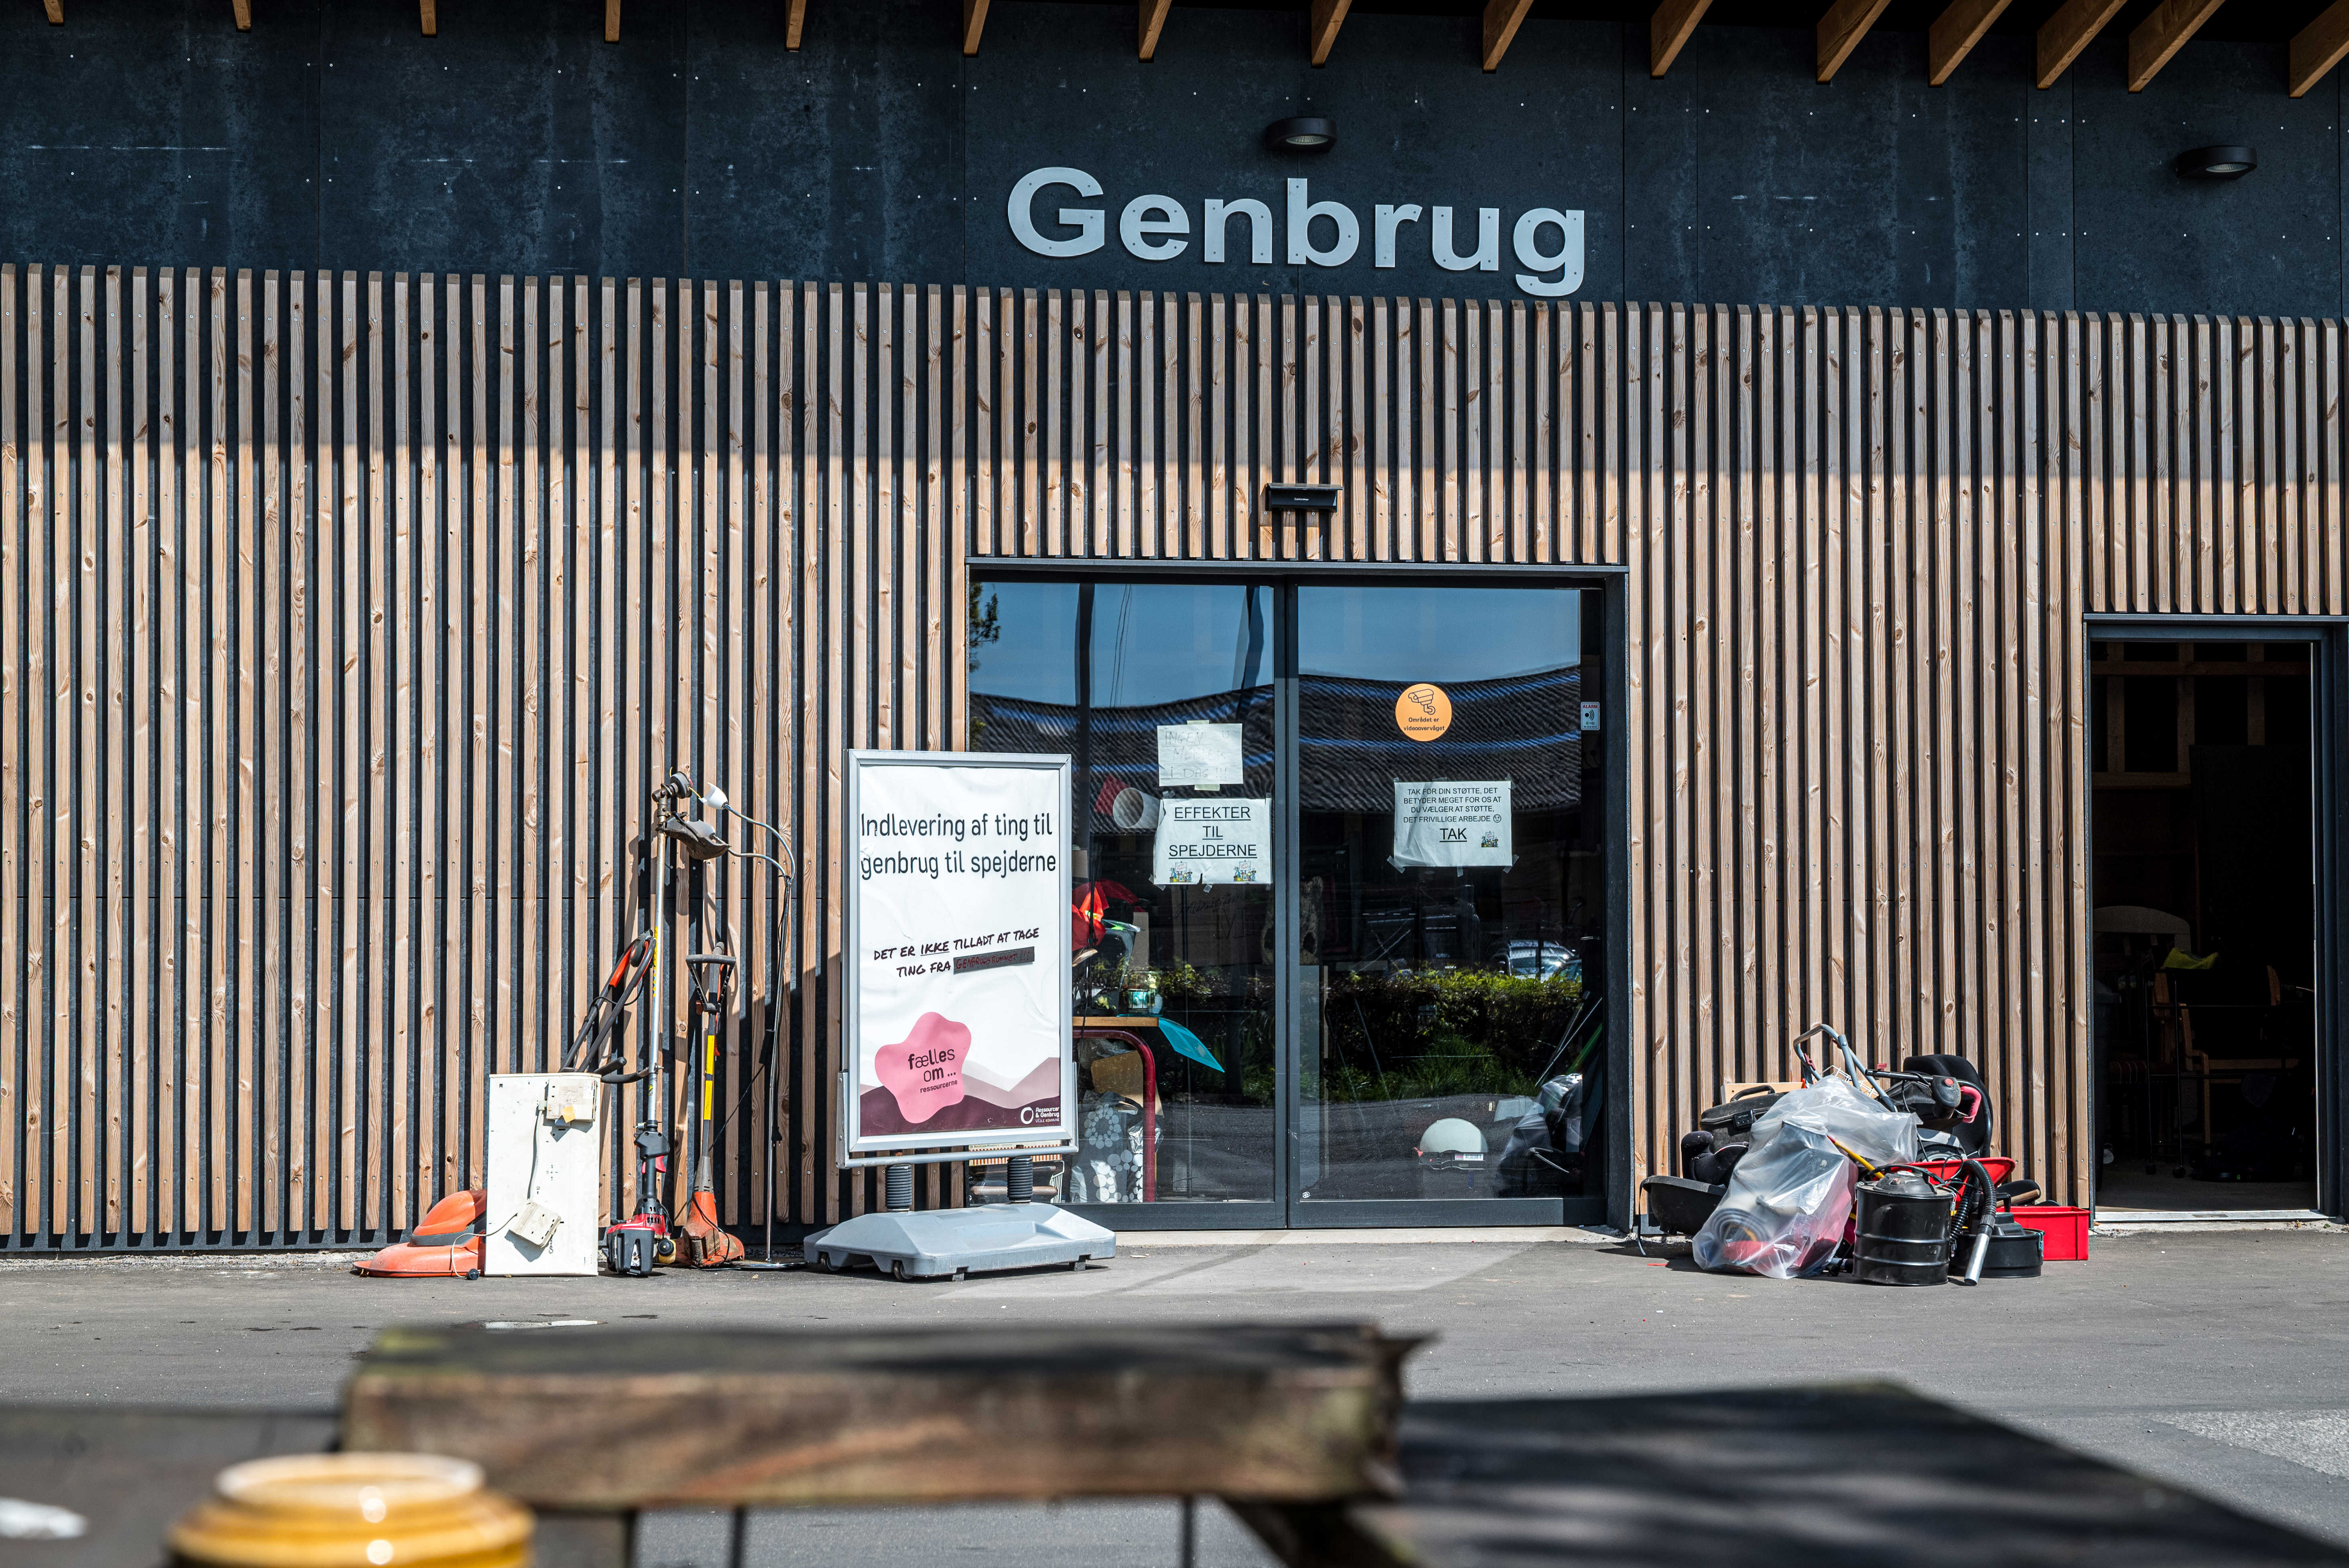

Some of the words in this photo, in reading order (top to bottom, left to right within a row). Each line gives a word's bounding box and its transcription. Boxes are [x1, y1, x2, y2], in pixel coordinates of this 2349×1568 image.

[1008, 167, 1585, 296] Genbrug
[1183, 768, 1209, 778] DAG
[1174, 806, 1251, 819] EFFEKTER
[862, 813, 965, 842] Indlevering
[971, 813, 988, 836] af
[995, 813, 1028, 841] ting
[1034, 813, 1052, 835] til
[1203, 826, 1223, 837] TIL
[1439, 828, 1467, 840] TAK
[1169, 844, 1257, 857] SPEJDERNE
[861, 851, 939, 880] genbrug
[945, 850, 965, 873] til
[971, 850, 1056, 878] spejderne
[874, 947, 897, 961] DET
[900, 946, 916, 957] ER
[920, 941, 949, 956] IKKE
[953, 934, 994, 950] TILLADT
[997, 932, 1011, 943] AT
[1013, 928, 1040, 940] TAGE
[897, 964, 926, 977] TING
[930, 961, 951, 973] FRA
[908, 1048, 955, 1070] fælles
[920, 1080, 958, 1093] ressourcerne
